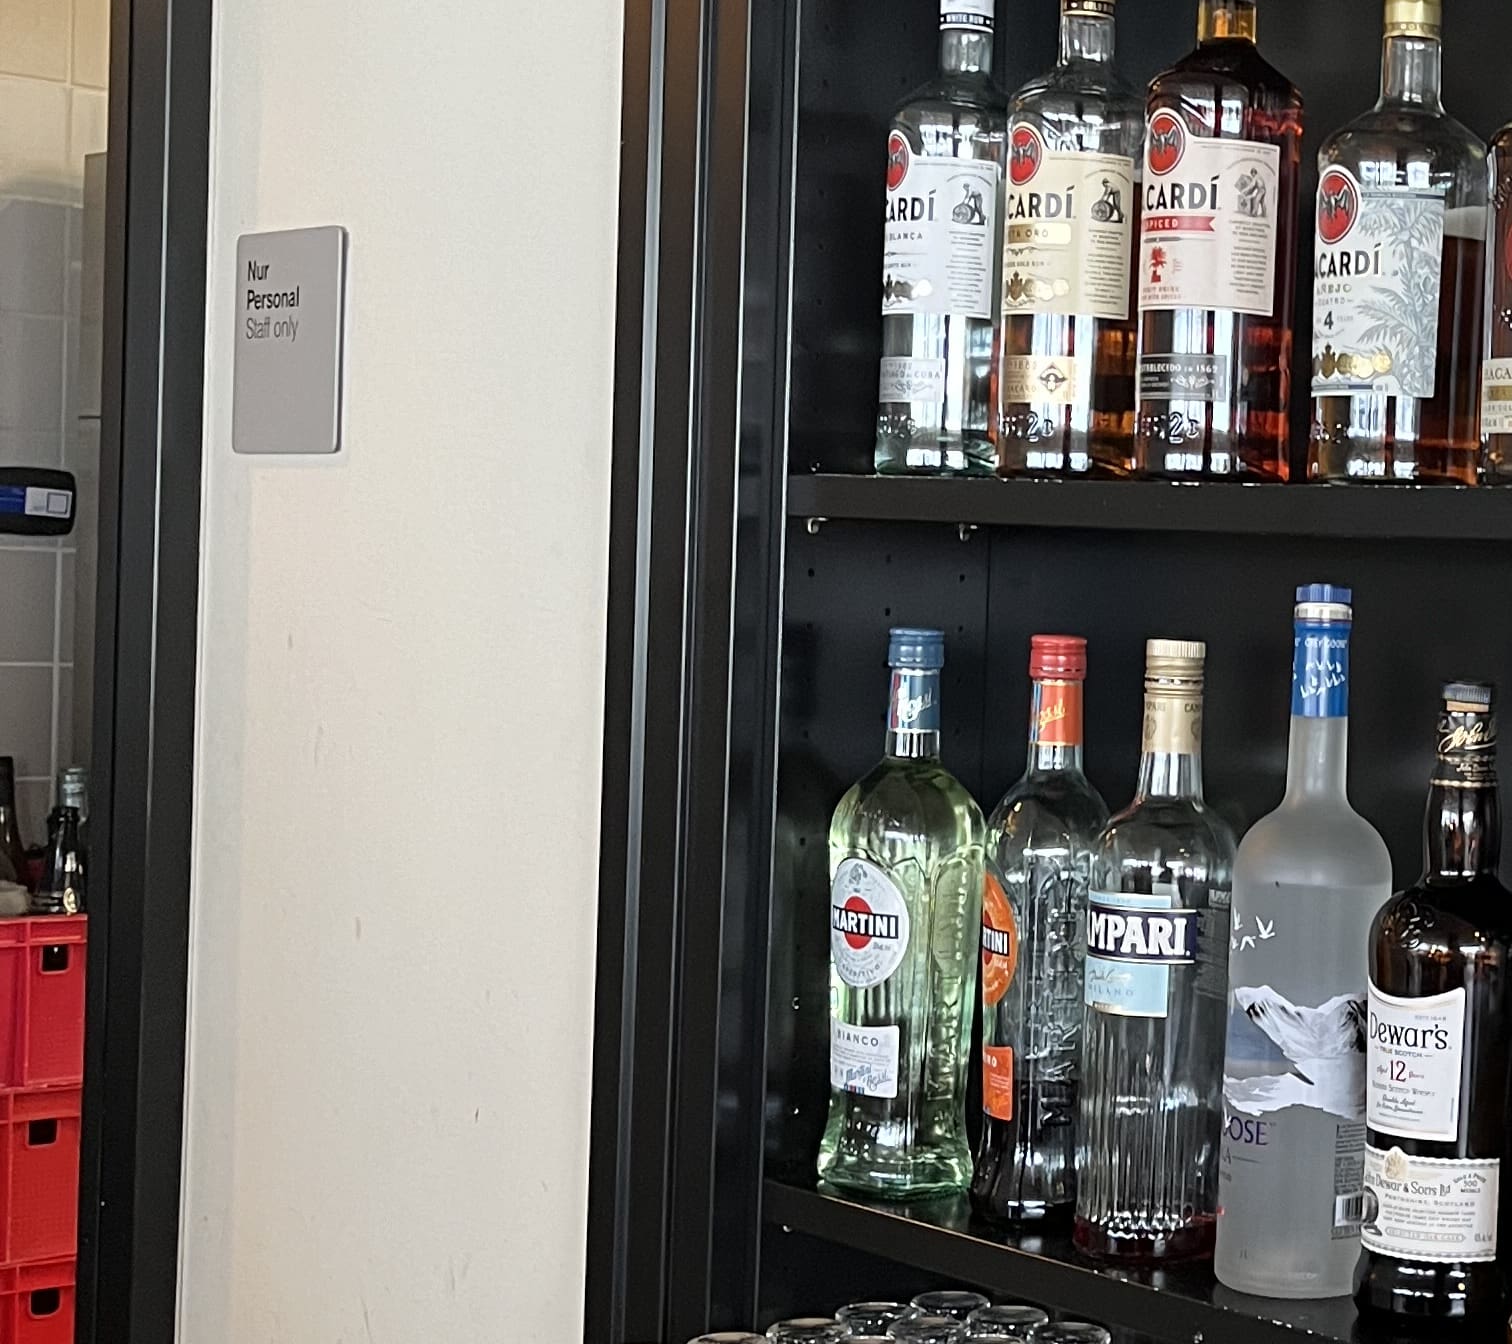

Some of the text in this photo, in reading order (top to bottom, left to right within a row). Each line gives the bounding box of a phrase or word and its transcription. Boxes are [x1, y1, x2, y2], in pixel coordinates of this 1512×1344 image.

[1008, 185, 1075, 219] CARDÍ
[1146, 175, 1220, 211] CARDÍ
[248, 260, 270, 281] Nur
[1317, 243, 1382, 278] CARDÍ
[247, 286, 300, 310] Personal
[246, 316, 299, 342] Staff only
[1324, 311, 1334, 330] 4
[833, 908, 896, 938] MARTINI
[983, 926, 1009, 954] RTINI
[837, 1029, 879, 1047] BIANCO
[1370, 1011, 1449, 1050] Dewar's
[1394, 1049, 1422, 1058] SCOTCH
[1390, 1060, 1407, 1083] 12
[1223, 1116, 1268, 1146] OSE
[1376, 1173, 1451, 1196] Dewar & Sons Ltd
